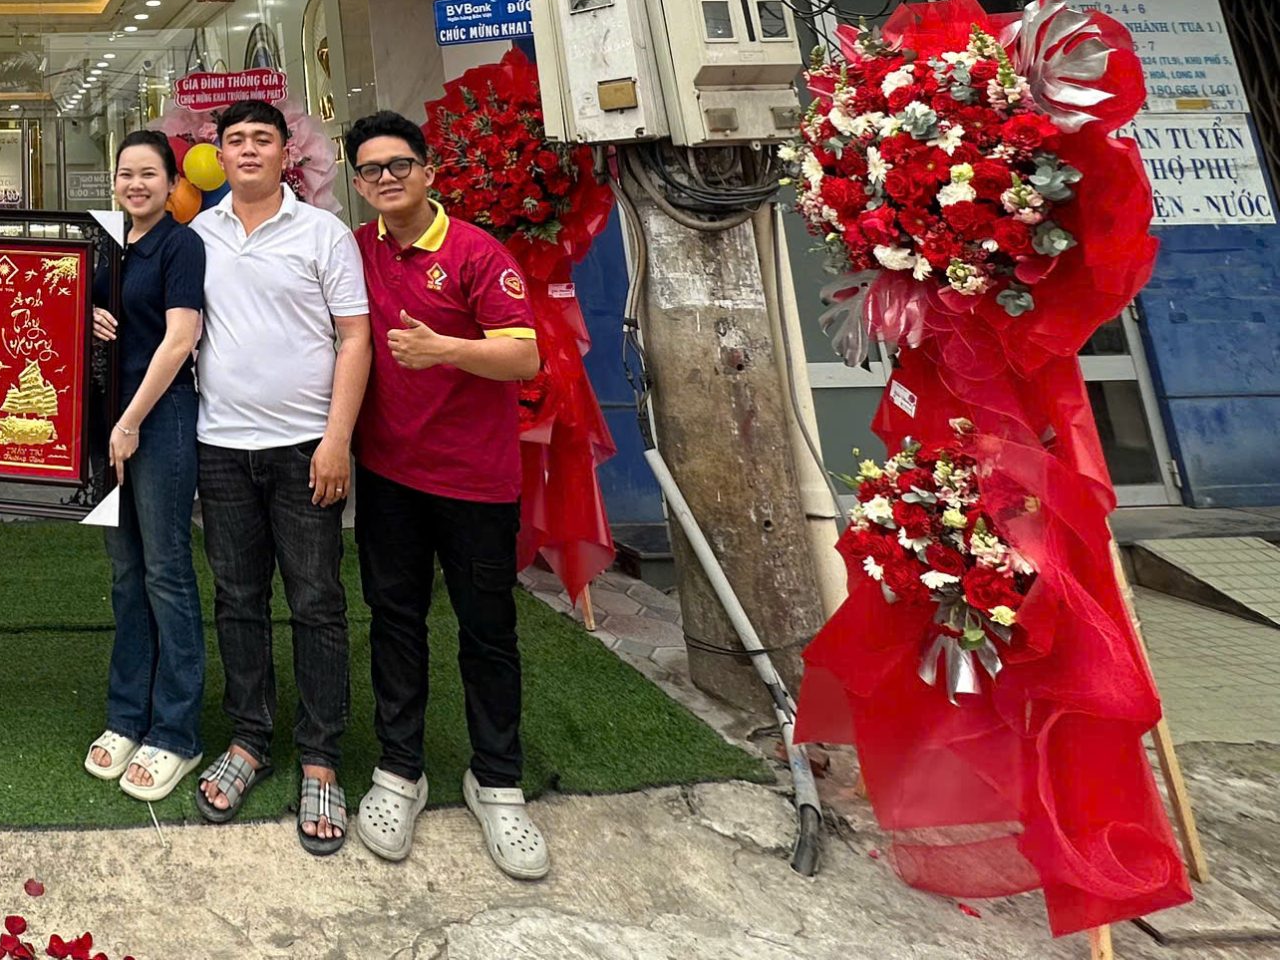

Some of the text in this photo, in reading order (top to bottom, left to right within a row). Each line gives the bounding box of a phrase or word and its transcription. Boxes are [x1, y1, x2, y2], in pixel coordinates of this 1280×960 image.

[446, 2, 492, 17] BVBank
[440, 21, 528, 42] CHÚC MỪNG KHAI
[182, 78, 199, 91] GIA
[262, 74, 279, 86] GIA
[1190, 158, 1238, 185] PHỤ
[1205, 189, 1273, 218] NƯỚC
